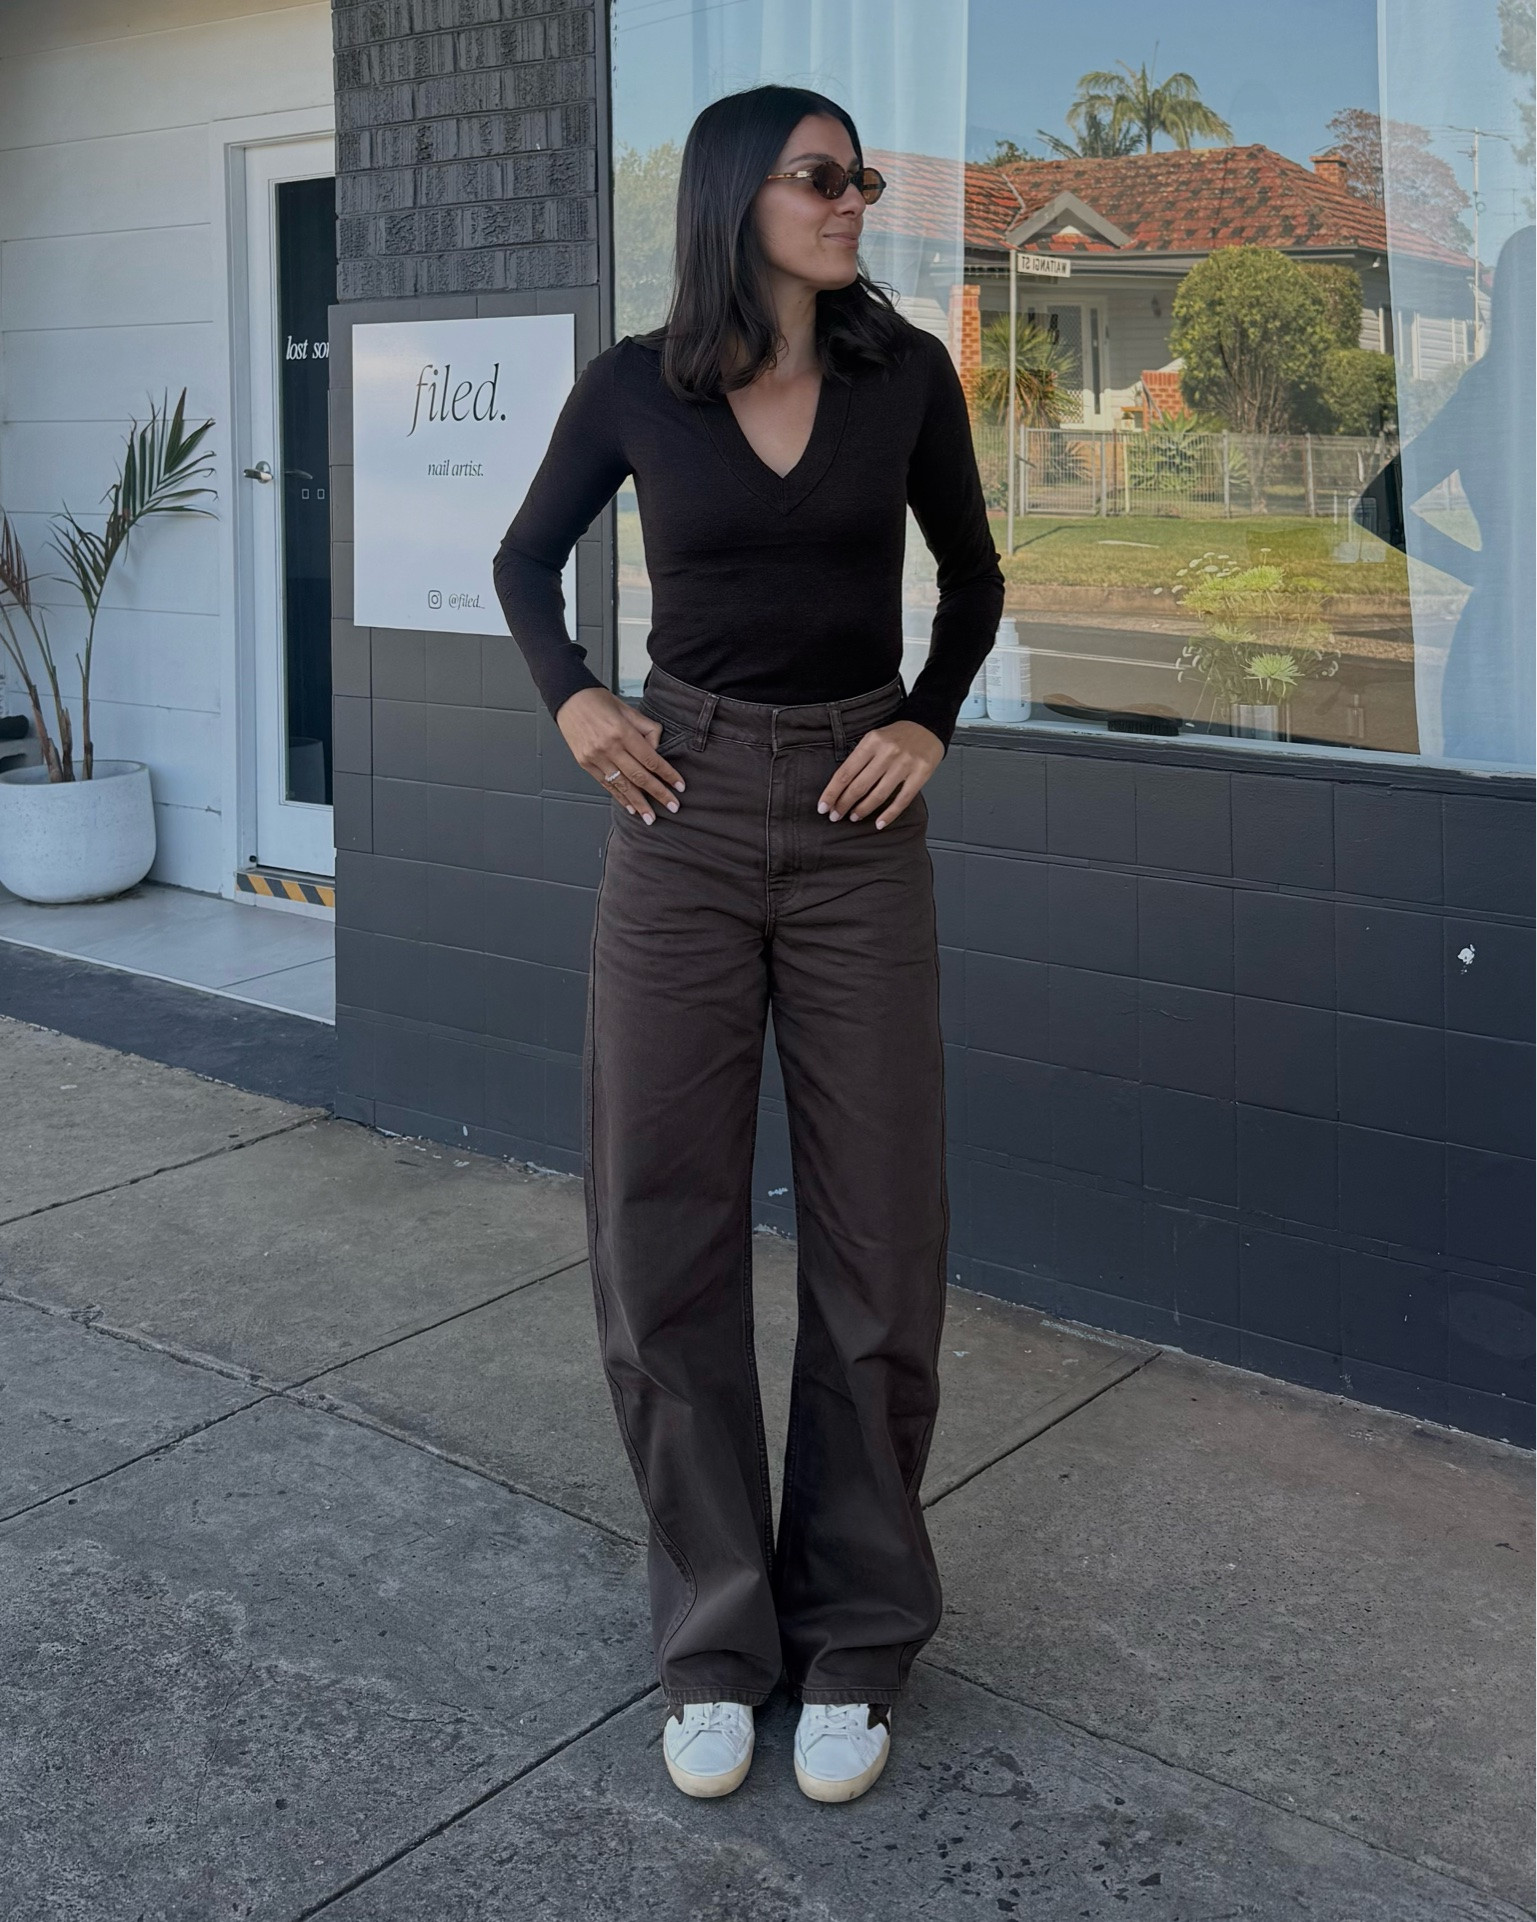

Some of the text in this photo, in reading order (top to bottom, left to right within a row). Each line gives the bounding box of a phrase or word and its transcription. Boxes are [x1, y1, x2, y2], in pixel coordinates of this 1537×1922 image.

[286, 335, 308, 360] lost
[407, 362, 506, 438] filed.
[427, 459, 484, 477] nail artist.
